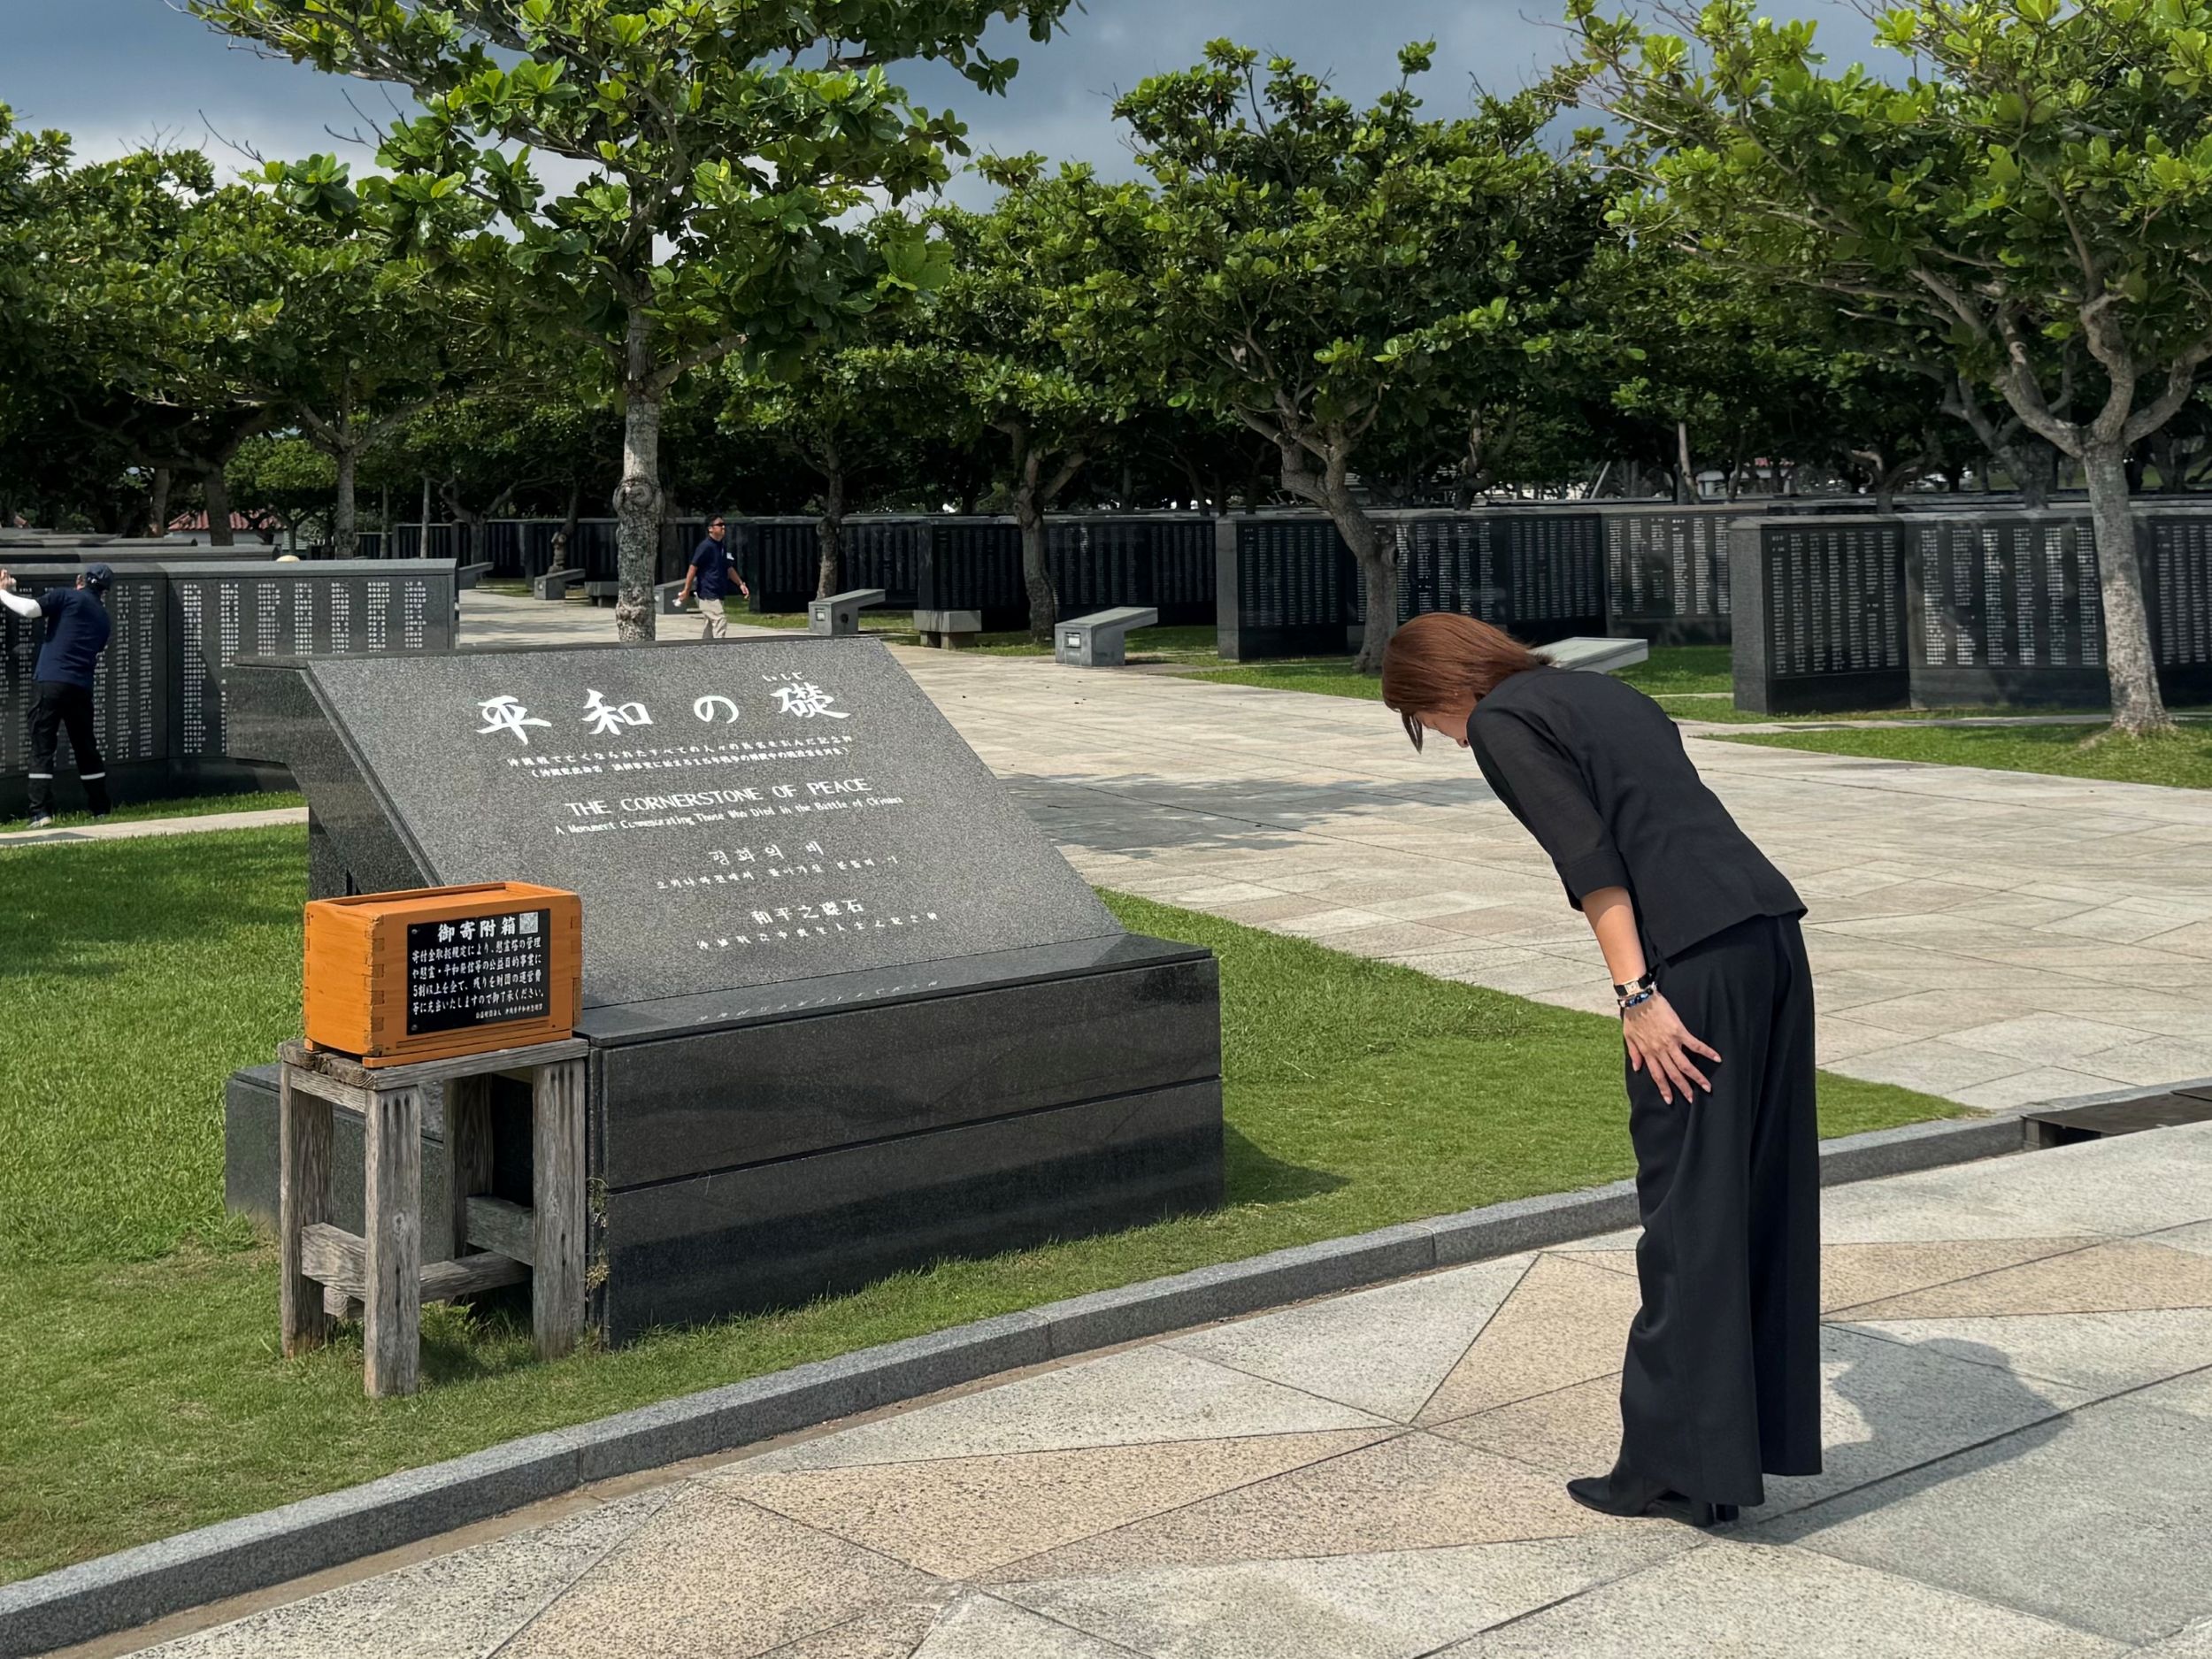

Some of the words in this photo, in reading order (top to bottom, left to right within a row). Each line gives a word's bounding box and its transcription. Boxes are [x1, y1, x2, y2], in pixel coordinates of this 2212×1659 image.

[474, 680, 851, 746] 平和の礎
[554, 825, 565, 835] A
[566, 820, 617, 833] Monument
[618, 814, 695, 829] Commemorating
[692, 811, 726, 822] Those
[726, 808, 749, 818] Who
[749, 805, 776, 818] Died
[778, 804, 793, 815] in
[794, 803, 812, 813] the
[812, 799, 849, 811] Battle
[851, 797, 864, 808] of
[563, 799, 613, 817] THE
[618, 786, 764, 811] CORNERSTONE
[770, 783, 797, 798] OF
[804, 777, 873, 795] PEACE
[707, 842, 785, 865] 평화의
[803, 840, 825, 856] 비
[437, 917, 515, 942] 御寄附箱
